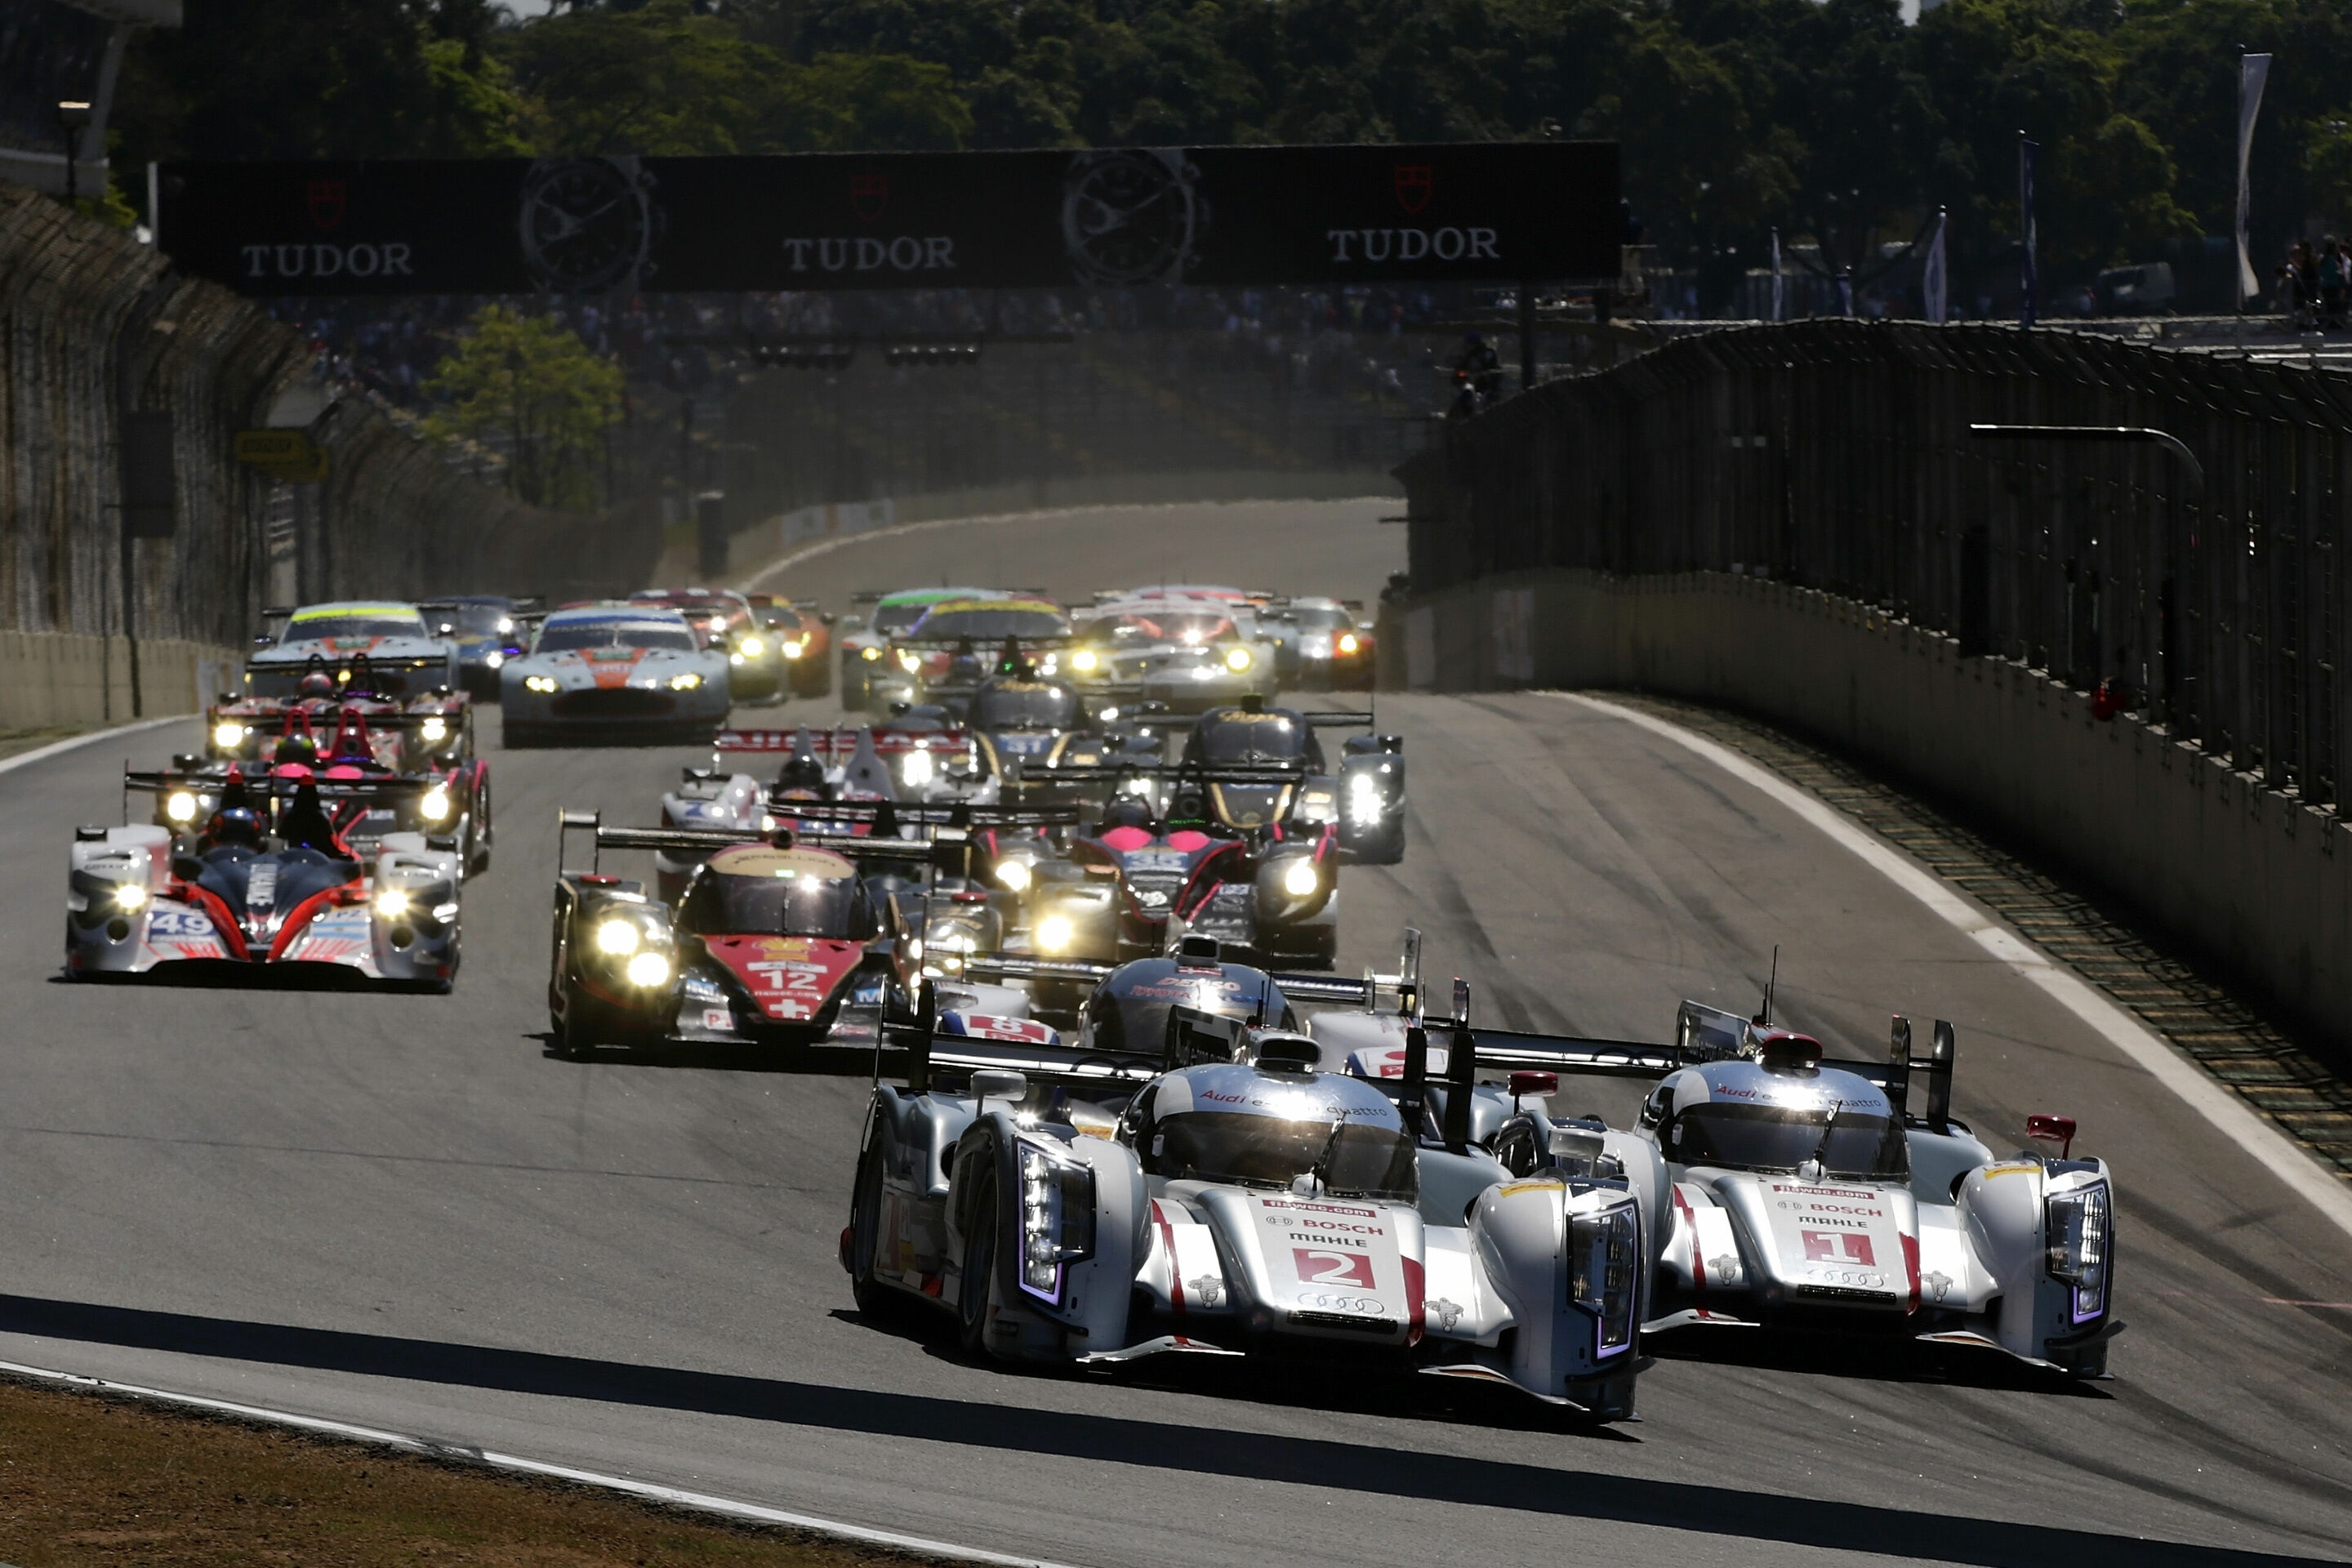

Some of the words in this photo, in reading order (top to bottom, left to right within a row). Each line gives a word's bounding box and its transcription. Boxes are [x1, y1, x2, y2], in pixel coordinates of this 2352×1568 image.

[782, 236, 957, 271] TUDOR
[1326, 227, 1501, 261] TUDOR
[242, 243, 414, 277] TUDOR
[151, 913, 214, 935] 49
[760, 969, 819, 990] 12
[991, 1016, 1024, 1034] 8
[1714, 1085, 1757, 1098] Audi
[1200, 1089, 1246, 1103] Audi
[1326, 1105, 1388, 1116] quattro
[1810, 1203, 1883, 1217] BOSCH
[1303, 1219, 1384, 1236] BOSCH
[1798, 1216, 1869, 1228] MAHLE
[1290, 1233, 1368, 1248] MAHLE
[1817, 1233, 1861, 1263] 1
[1307, 1250, 1363, 1287] 2
